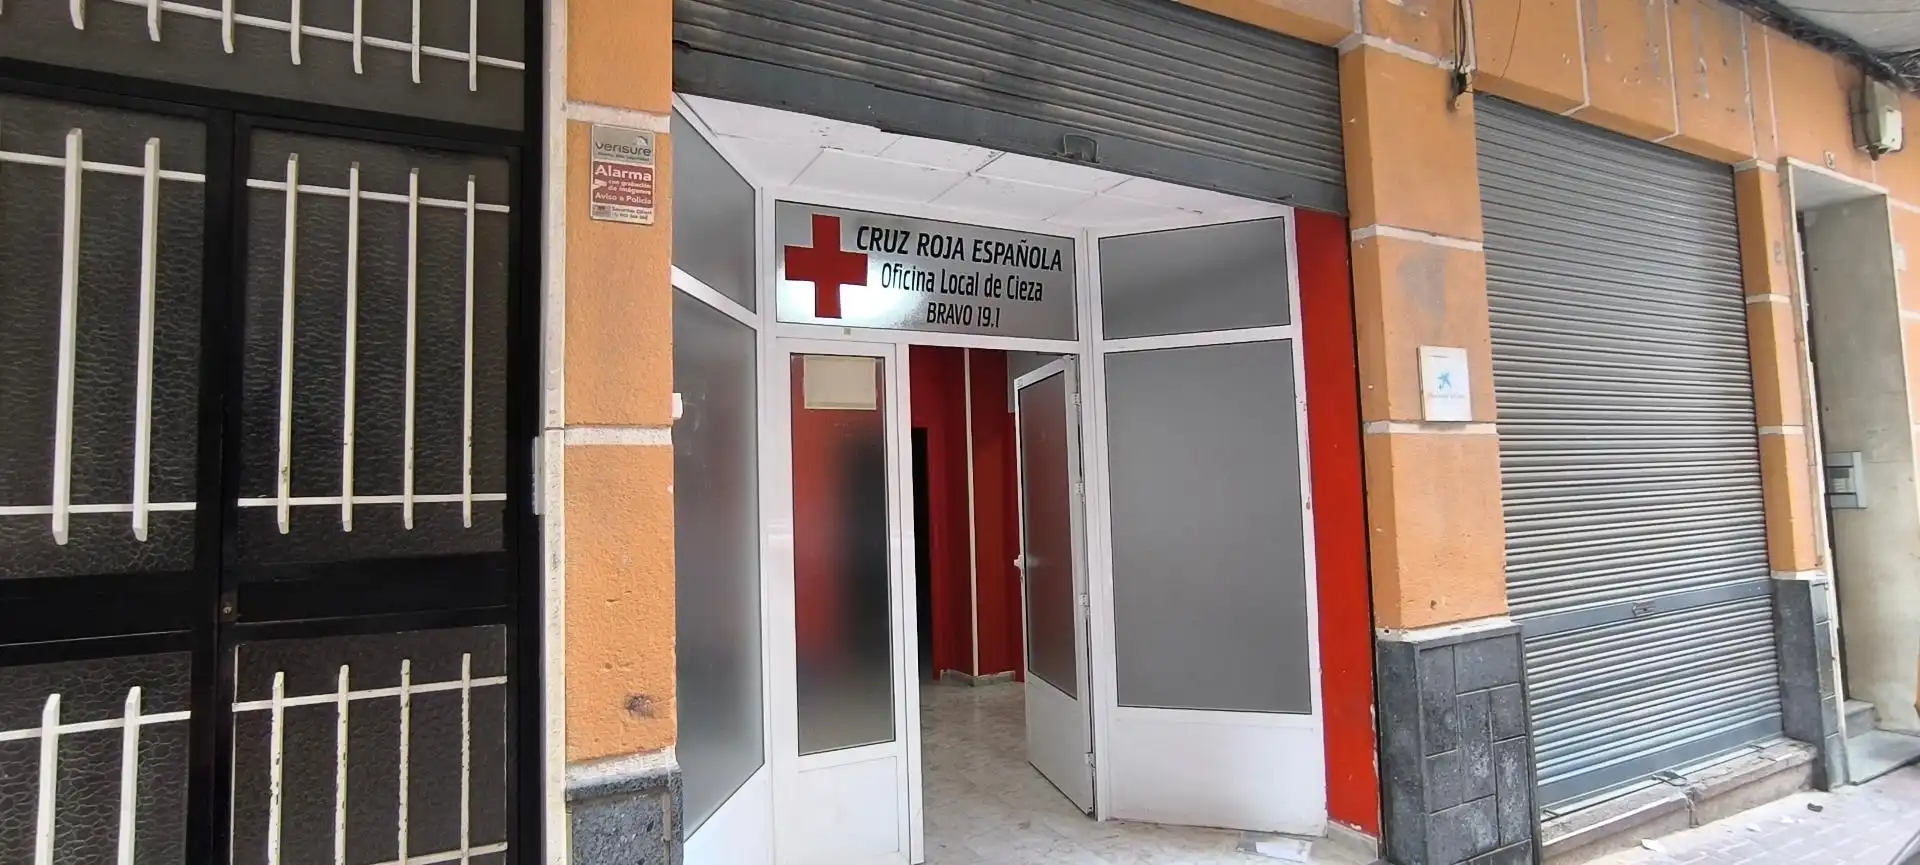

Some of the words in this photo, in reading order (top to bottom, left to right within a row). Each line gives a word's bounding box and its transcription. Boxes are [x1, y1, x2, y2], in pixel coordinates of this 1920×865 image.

[595, 141, 652, 157] verisure
[595, 164, 652, 181] Alarma
[595, 192, 617, 201] Aviso
[856, 225, 911, 255] CRUZ
[916, 232, 965, 261] ROJA
[971, 239, 1063, 272] ESPAÑOLA
[881, 262, 934, 293] Oficina
[940, 268, 979, 297] Local
[984, 273, 1001, 298] de
[1006, 275, 1043, 302] Cieza
[926, 302, 972, 326] BRAVO
[977, 306, 1000, 329] 19.1
